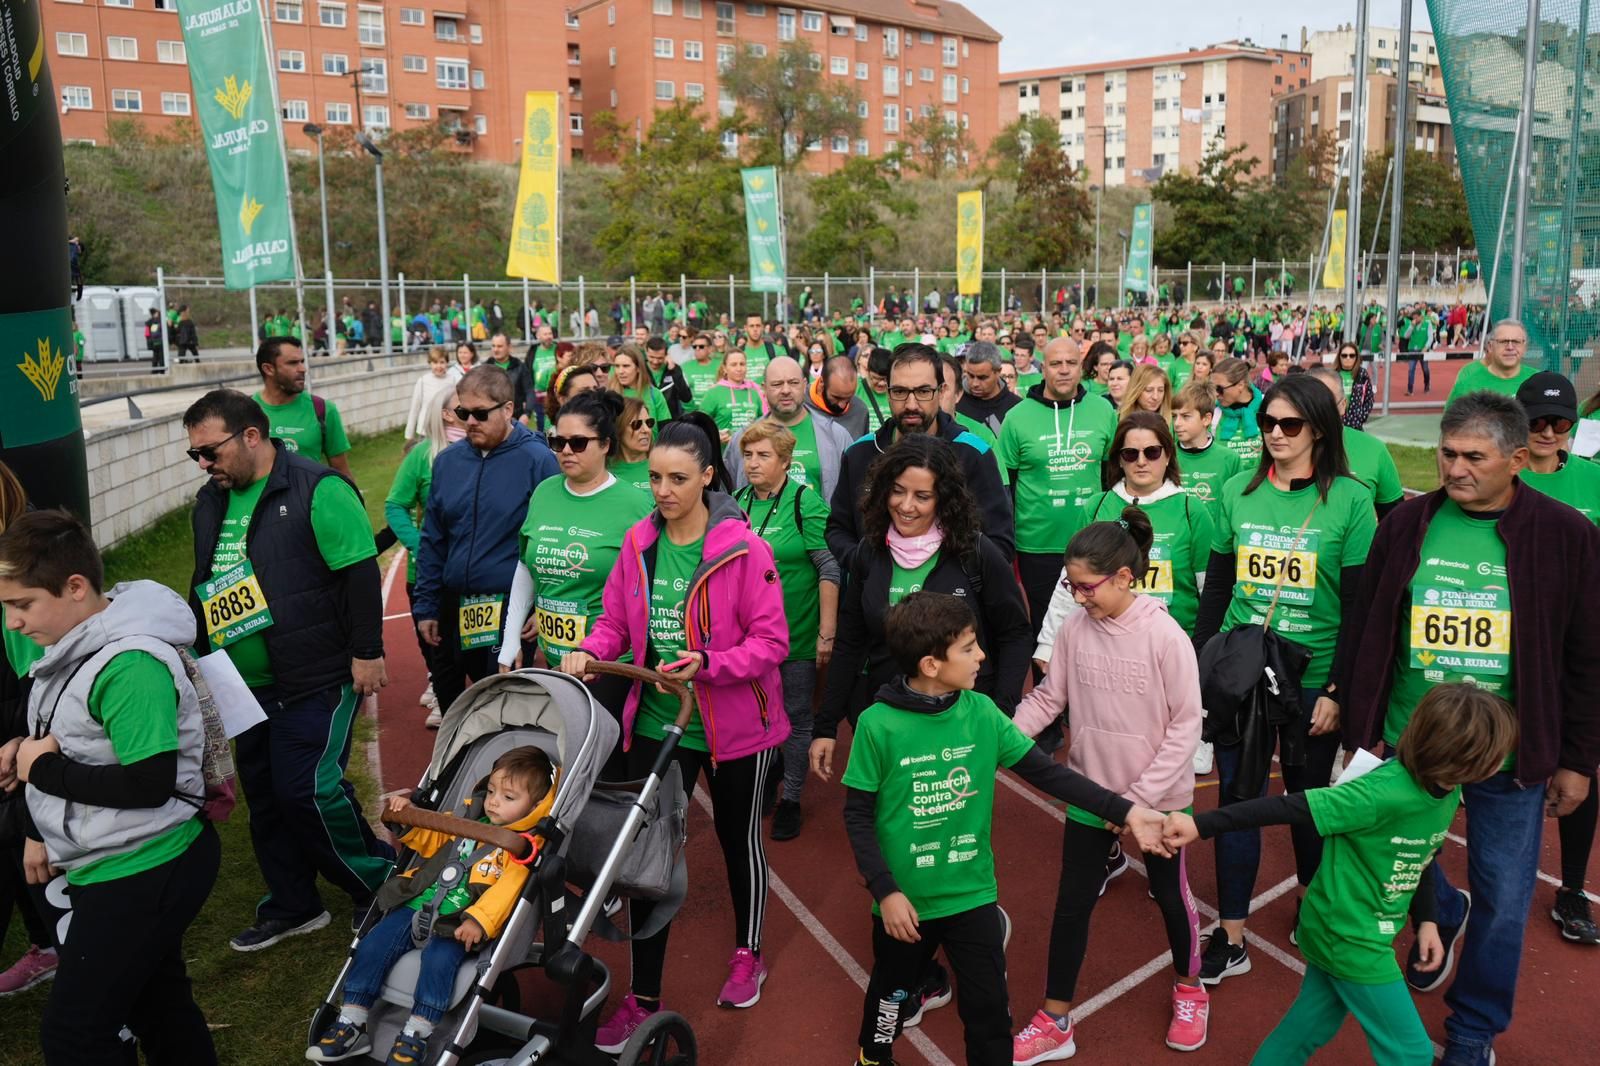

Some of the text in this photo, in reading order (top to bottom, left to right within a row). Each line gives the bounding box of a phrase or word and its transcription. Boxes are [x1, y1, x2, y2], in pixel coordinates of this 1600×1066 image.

[5, 7, 21, 81] VALLADOLID
[4, 65, 20, 121] CORRILLO
[1049, 456, 1076, 465] contra
[536, 544, 589, 561] En marcha
[535, 556, 567, 567] contra
[1249, 553, 1301, 583] 6516
[536, 565, 581, 579] el cáncer
[1434, 574, 1465, 586] ZAMORA
[1441, 590, 1497, 602] FUNDACION
[210, 585, 256, 627] 6883
[1465, 600, 1497, 609] RURAL
[463, 605, 494, 630] 3962
[658, 607, 684, 619] marc
[244, 615, 268, 631] RURAL
[538, 612, 576, 642] 3963
[650, 617, 680, 629] ontra
[657, 629, 686, 641] cánc
[1425, 613, 1492, 648] 6518
[1463, 657, 1503, 669] RURAL
[911, 769, 937, 779] ZAMORA
[912, 774, 971, 793] En marcha
[912, 791, 952, 805] contra
[913, 799, 967, 817] el cáncer
